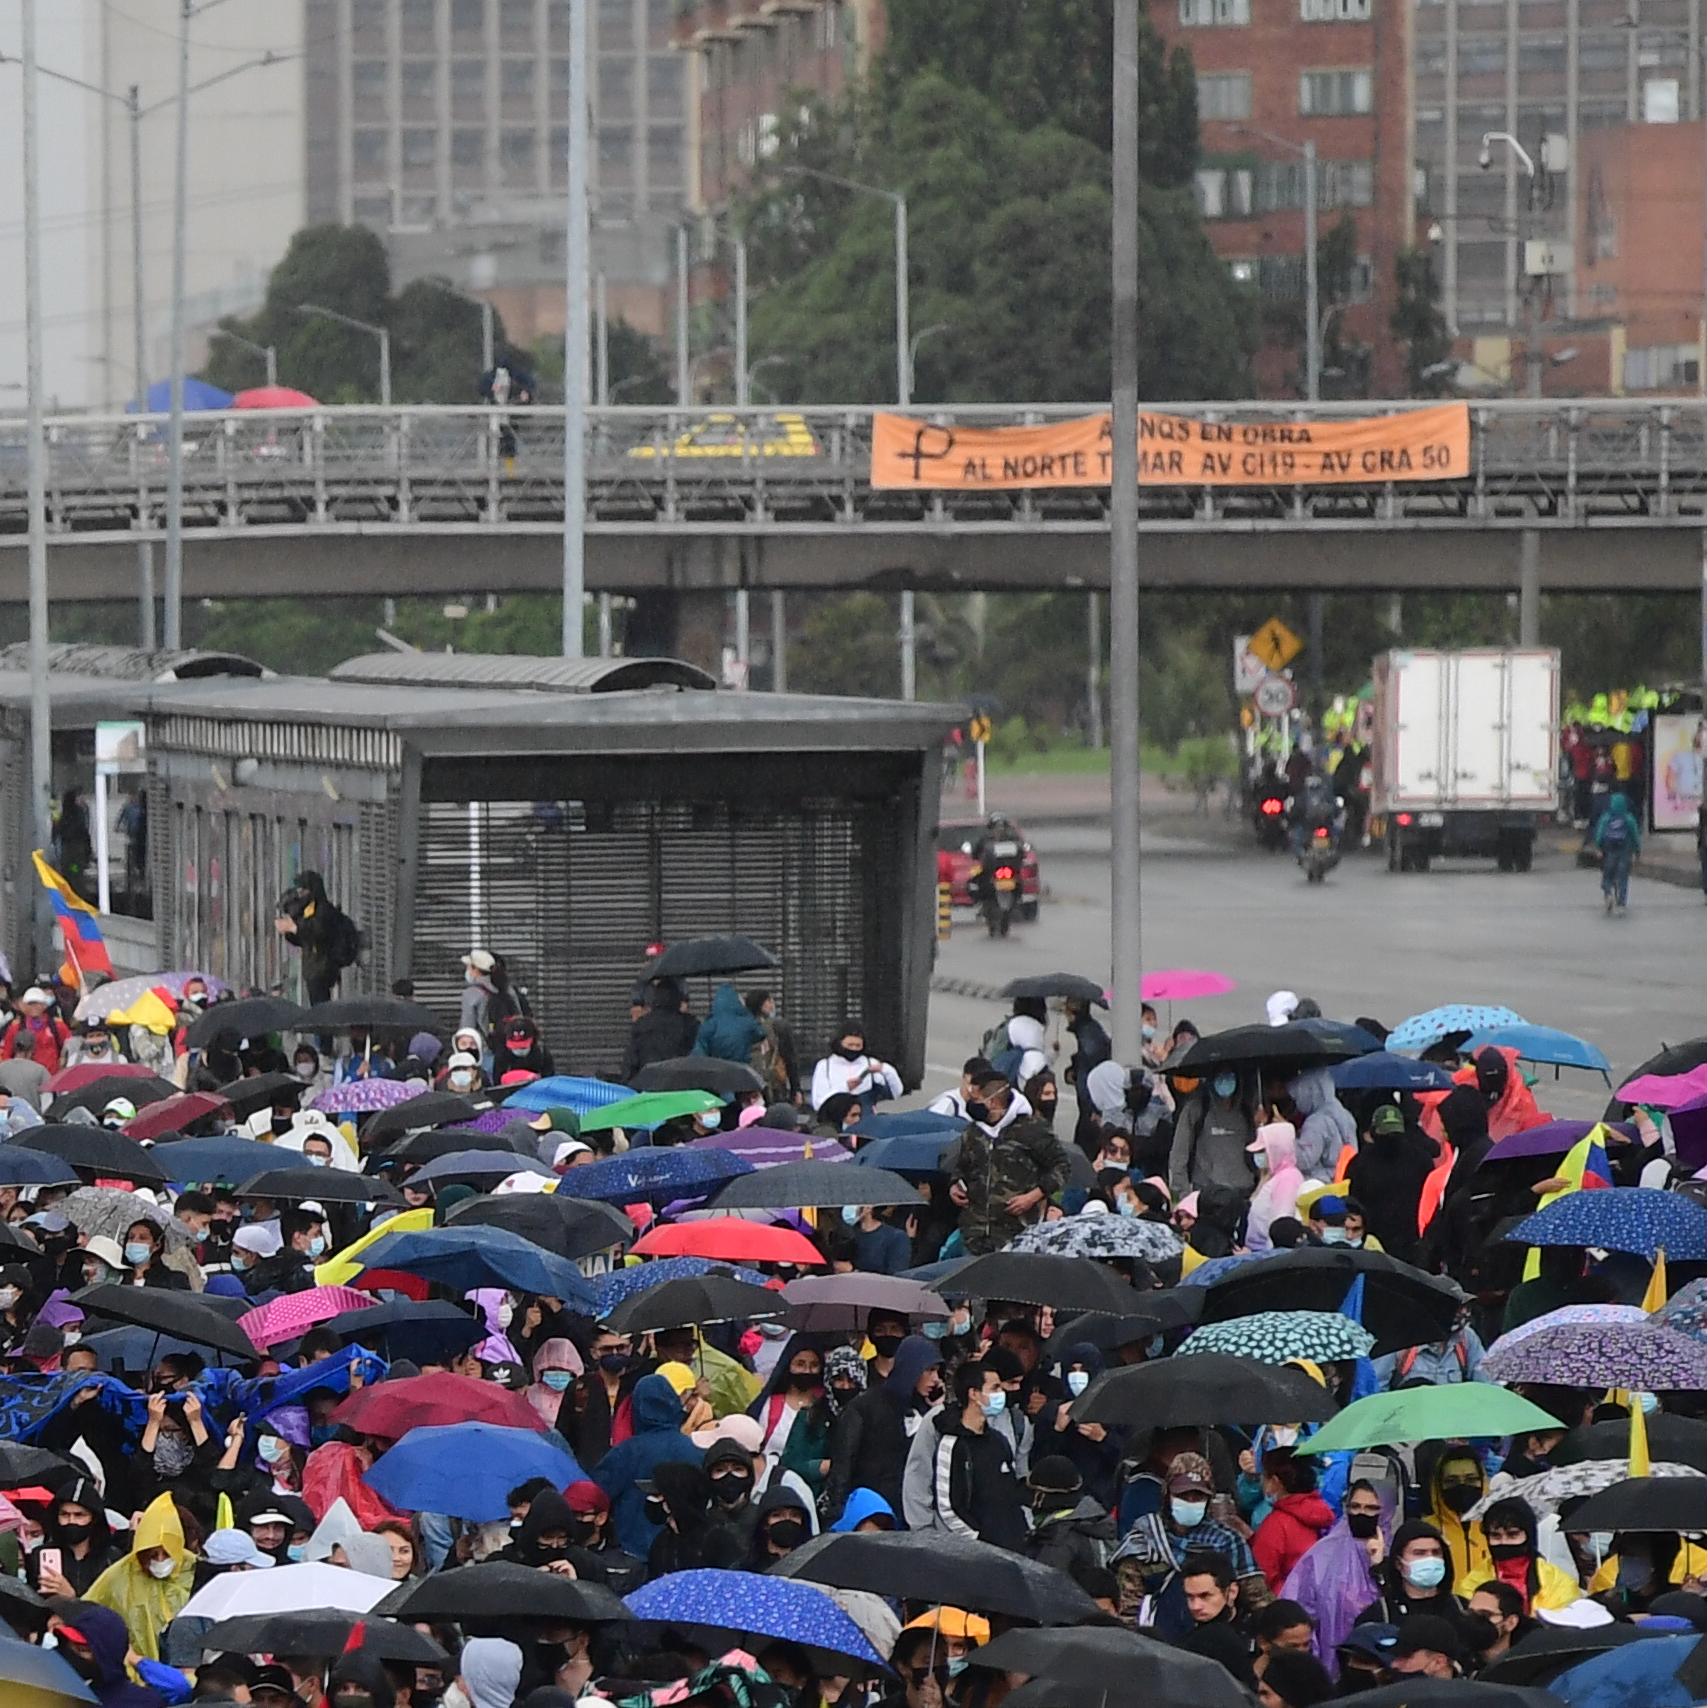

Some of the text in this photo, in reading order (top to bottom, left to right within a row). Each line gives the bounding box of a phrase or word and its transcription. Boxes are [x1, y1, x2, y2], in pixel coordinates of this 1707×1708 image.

[1098, 420, 1114, 440] A
[1139, 422, 1190, 442] NQS
[1200, 422, 1234, 443] EN
[962, 457, 992, 482] AL
[1003, 453, 1084, 480] NORTE
[1096, 451, 1183, 476] TMAR
[1201, 451, 1230, 475] AV
[1322, 448, 1352, 473] AV
[1422, 445, 1451, 470] 50
